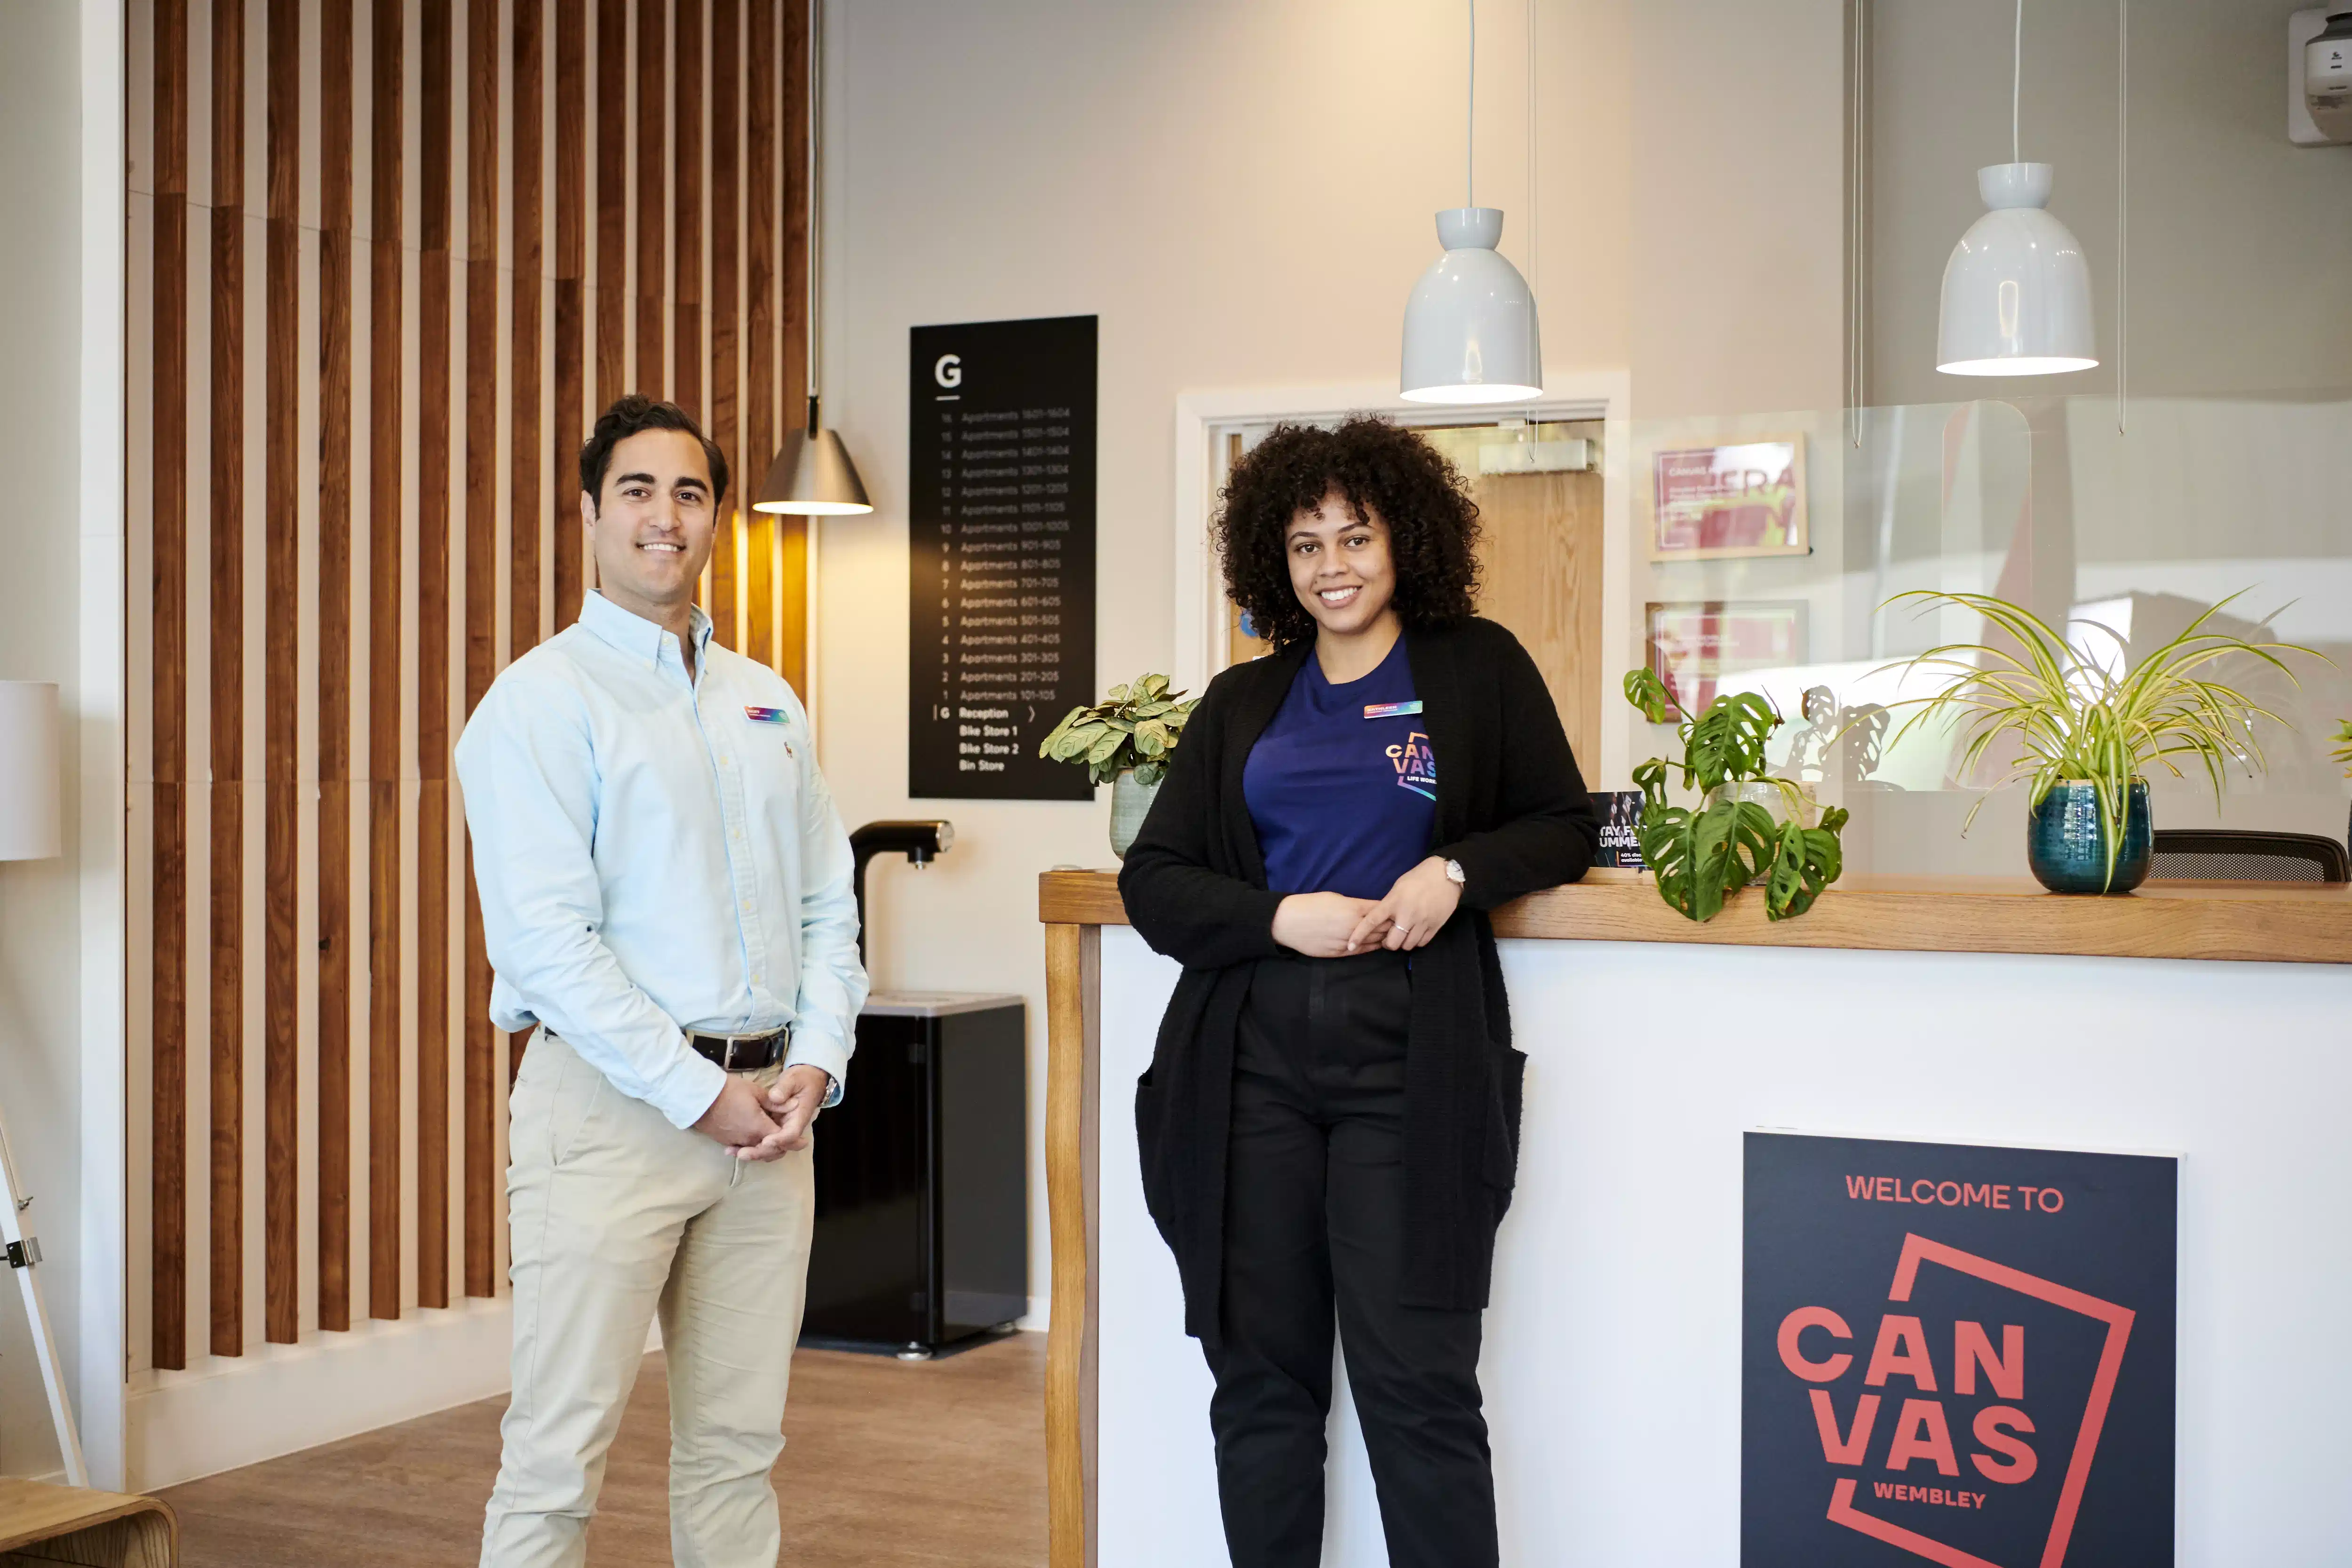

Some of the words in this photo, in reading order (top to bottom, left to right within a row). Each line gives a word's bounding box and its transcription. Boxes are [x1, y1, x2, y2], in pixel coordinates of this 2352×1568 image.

[935, 354, 961, 388] G
[942, 542, 950, 553] 9
[961, 542, 1017, 553] Apartments
[942, 561, 950, 572] 8
[961, 561, 1017, 573] Apartments
[942, 578, 949, 590] 7
[961, 579, 1017, 590] Apartments
[942, 597, 949, 609] 6
[961, 597, 1017, 609] Apartments
[942, 615, 949, 627] 5
[961, 616, 1017, 628] Apartments
[942, 635, 949, 645] 4
[960, 635, 1017, 646] Apartments
[943, 653, 949, 664] 3
[960, 653, 1017, 665] Apartments
[942, 671, 948, 683] 2
[960, 672, 1017, 683] Apartments
[943, 690, 948, 701] 1
[960, 690, 1017, 701] Apartments
[940, 707, 950, 719] G
[959, 707, 1009, 721] Reception
[959, 724, 981, 737] Bike
[983, 724, 1010, 737] Store
[1012, 725, 1017, 736] 1
[959, 742, 981, 754] Bike
[983, 742, 1010, 755] Store
[1012, 743, 1019, 755] 2
[959, 759, 976, 771] Bin
[978, 759, 1005, 772] Store
[1600, 825, 1621, 836] TAY
[1599, 836, 1641, 847] UMME
[1845, 1174, 2010, 1210] WELCOME
[2018, 1186, 2064, 1213] TO
[1777, 1305, 2024, 1400] CAN
[1808, 1389, 2038, 1485] VAS
[1873, 1481, 1986, 1509] WEMBLEY
